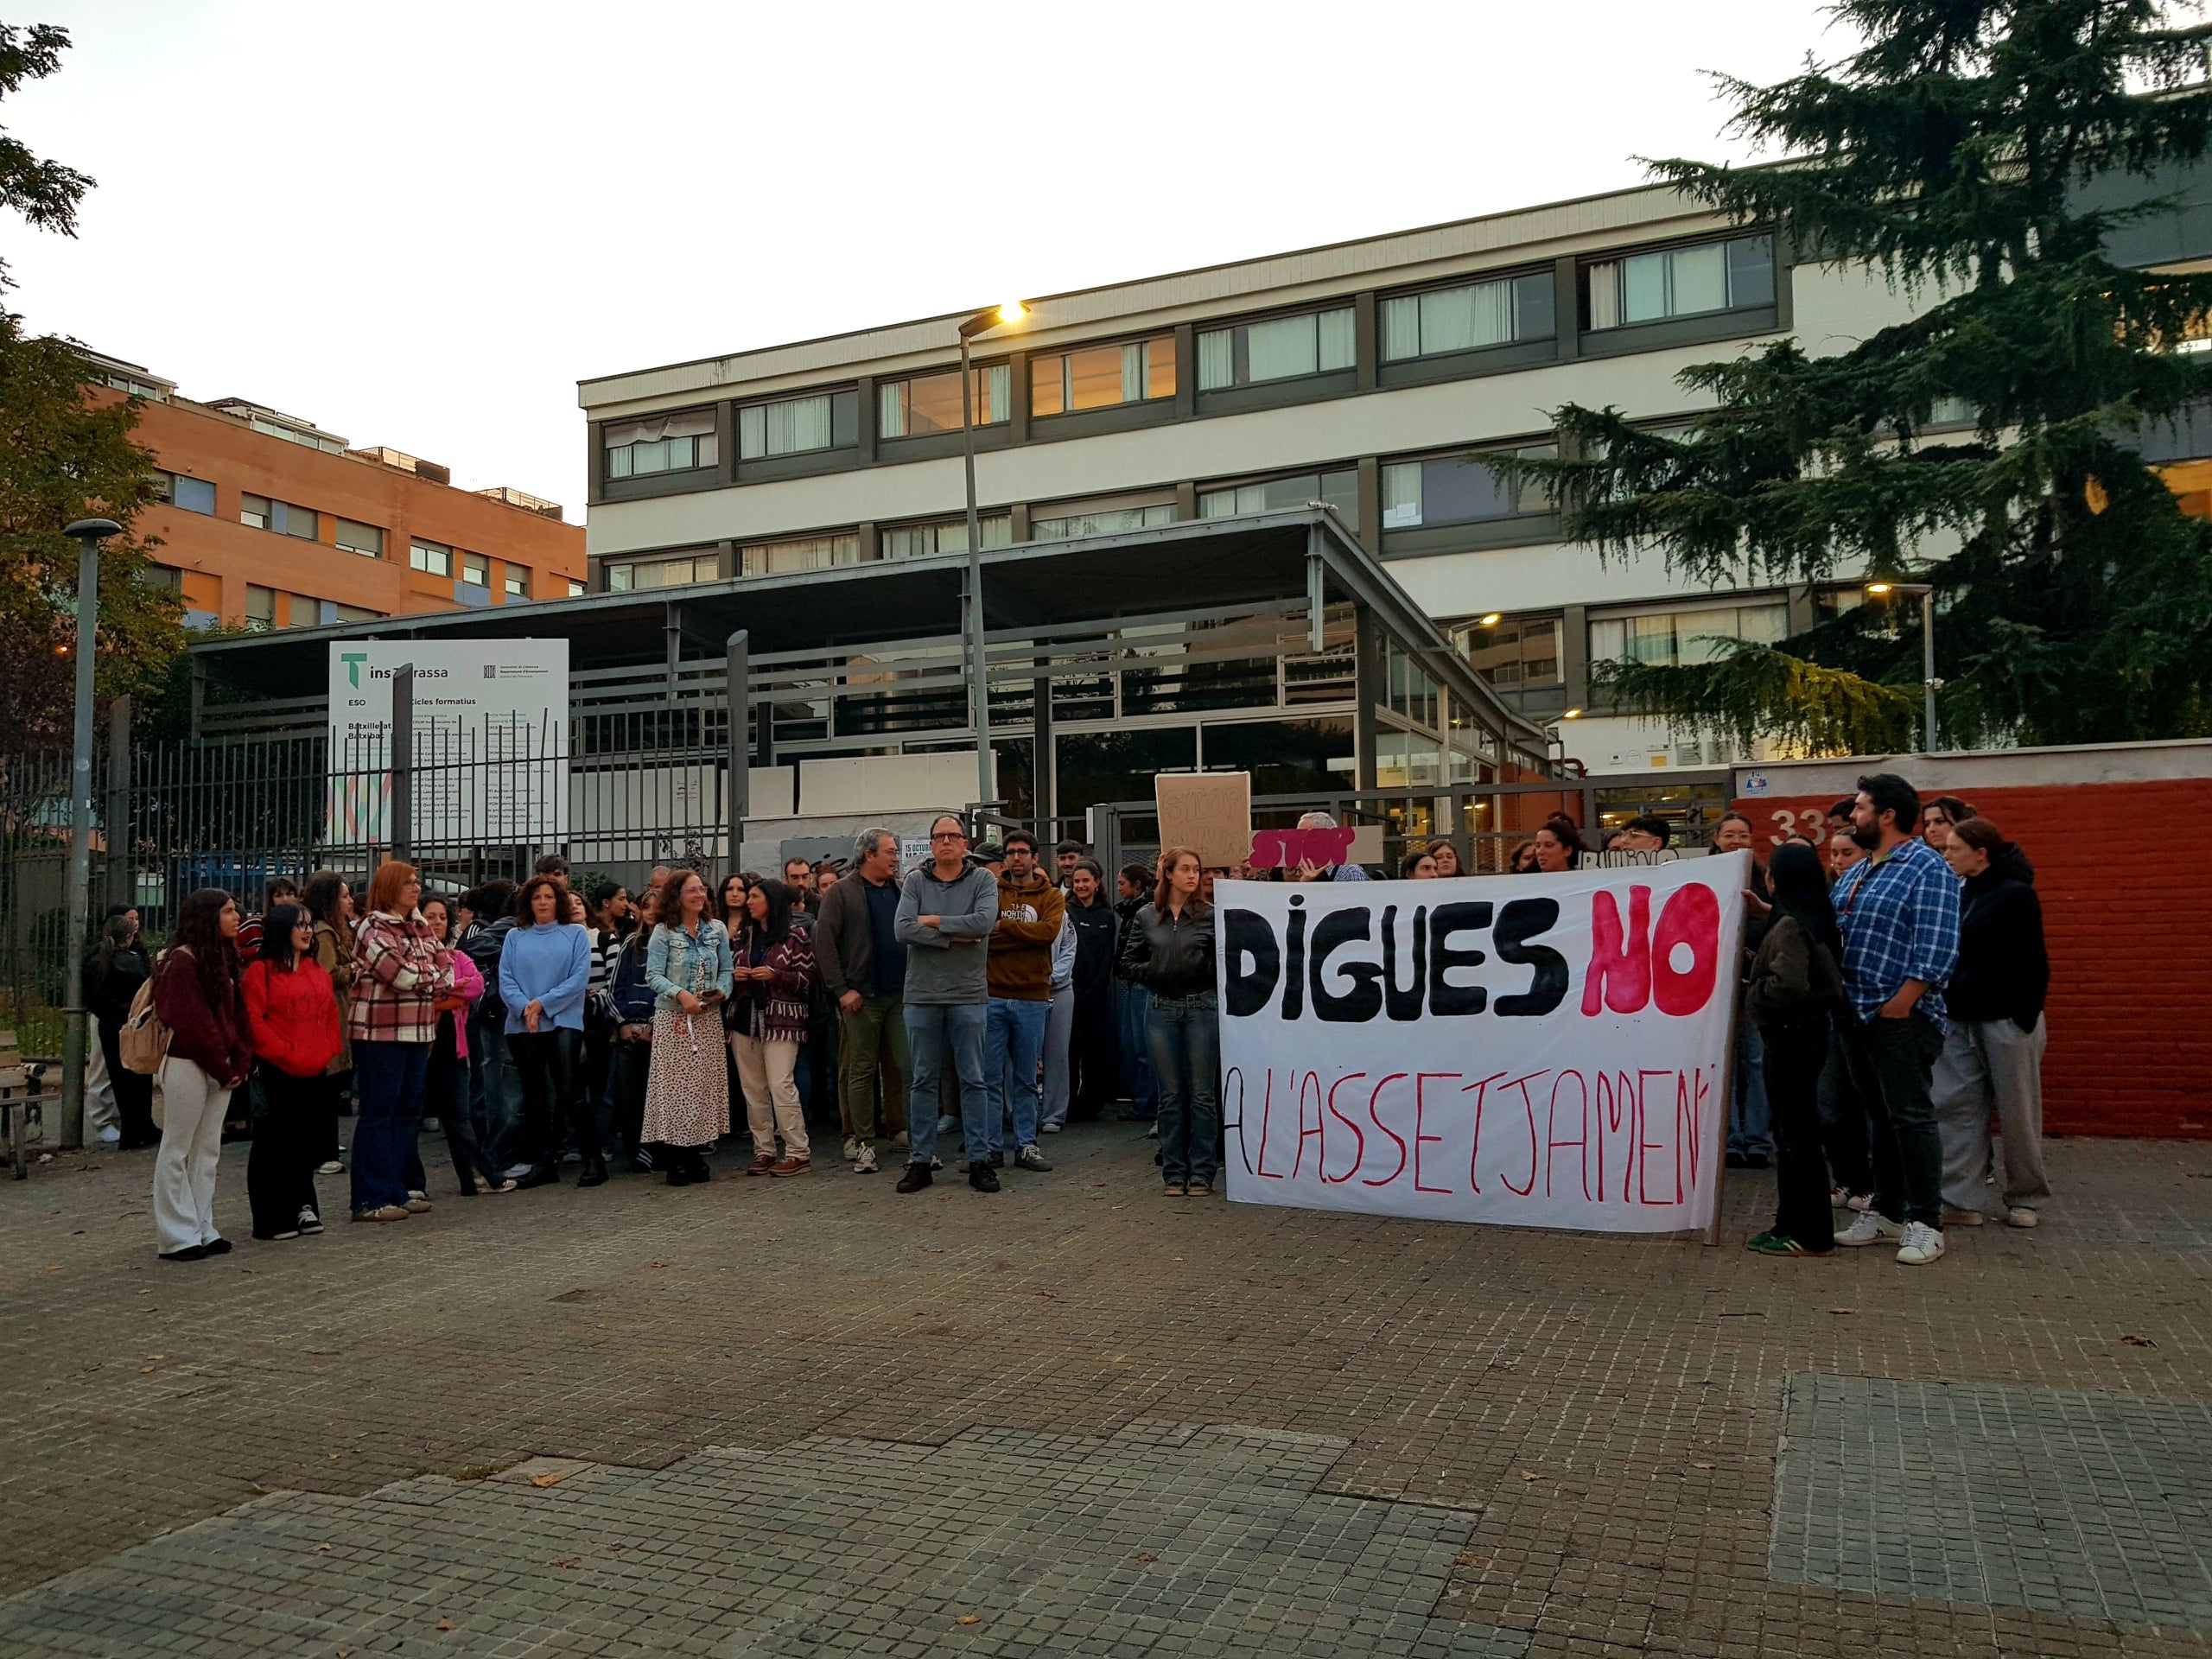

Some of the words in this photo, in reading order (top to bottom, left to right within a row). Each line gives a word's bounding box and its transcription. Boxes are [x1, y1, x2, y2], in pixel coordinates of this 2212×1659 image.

[1249, 827, 1355, 868] STOP
[1770, 809, 1826, 847] 33
[1580, 882, 1720, 1016] NO
[1224, 1066, 1253, 1176] A
